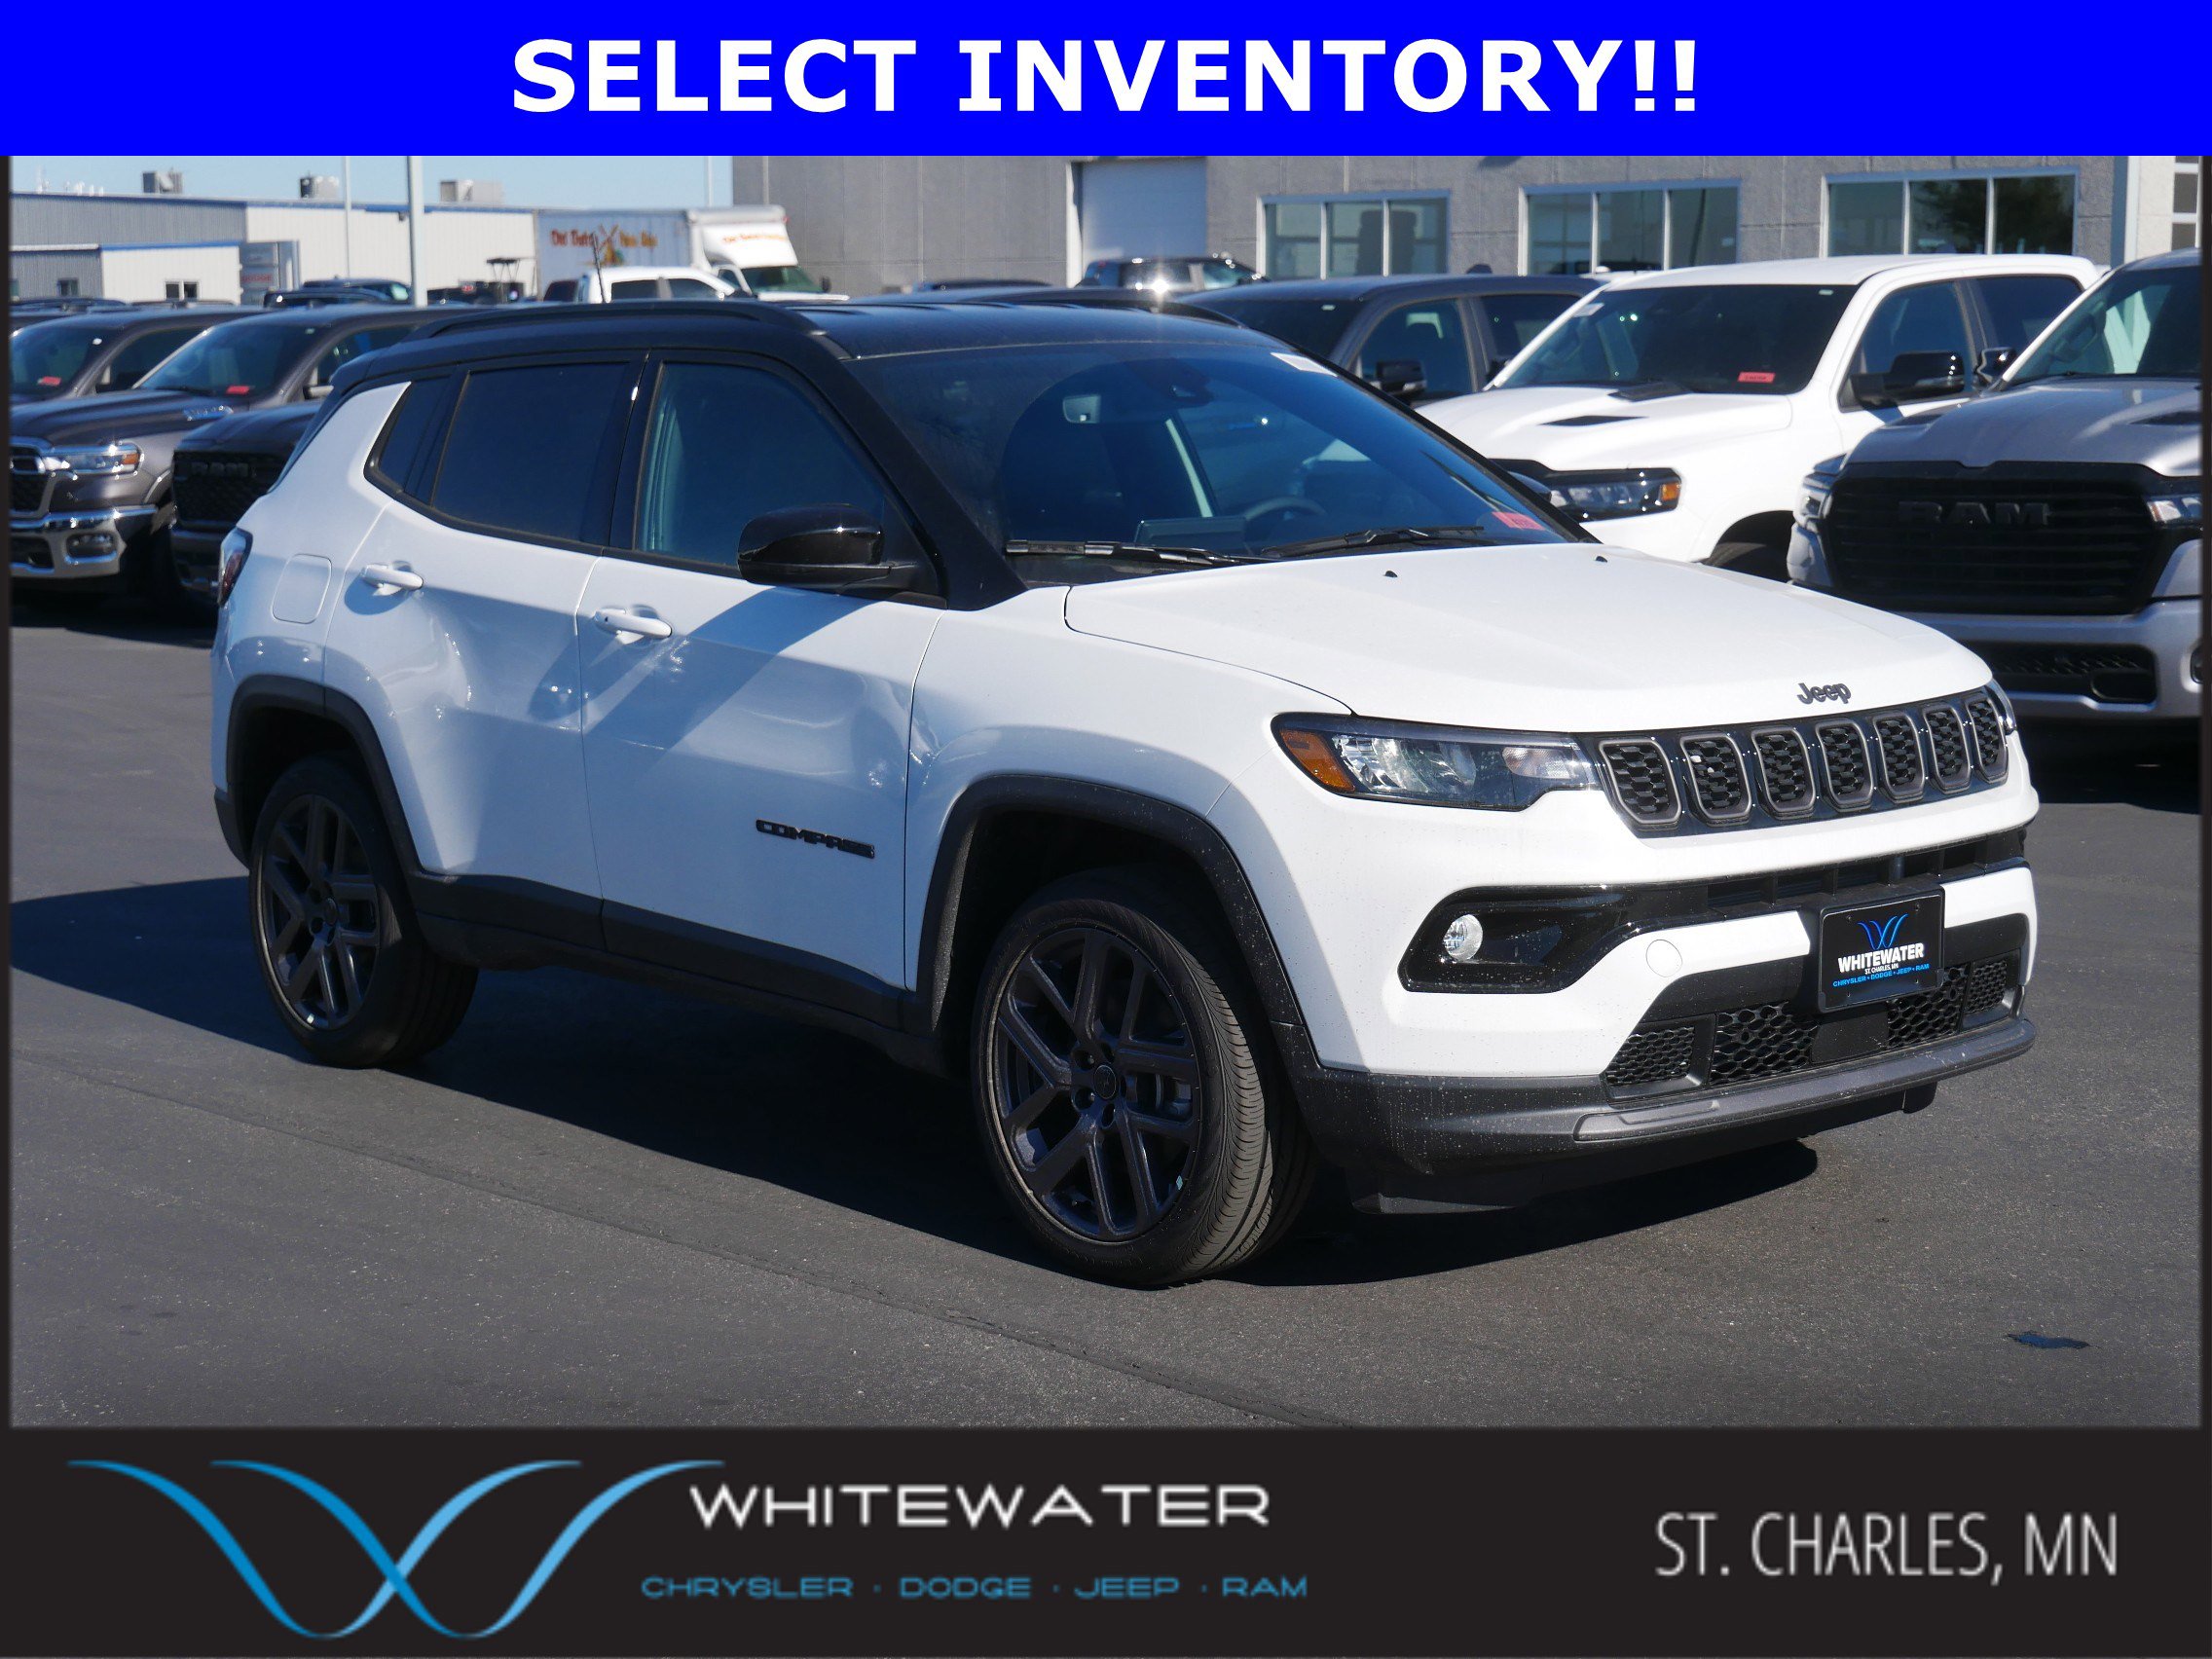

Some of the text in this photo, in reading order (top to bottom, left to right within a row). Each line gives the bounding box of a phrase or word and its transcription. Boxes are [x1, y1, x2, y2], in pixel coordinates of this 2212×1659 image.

[1898, 500, 2049, 525] RAM
[1796, 682, 1852, 704] Jeep
[1837, 941, 1925, 974] WHITEWATER
[1832, 976, 1866, 987] CHRYSLER
[1870, 971, 1893, 980] DODGE
[1915, 963, 1930, 972] RAM
